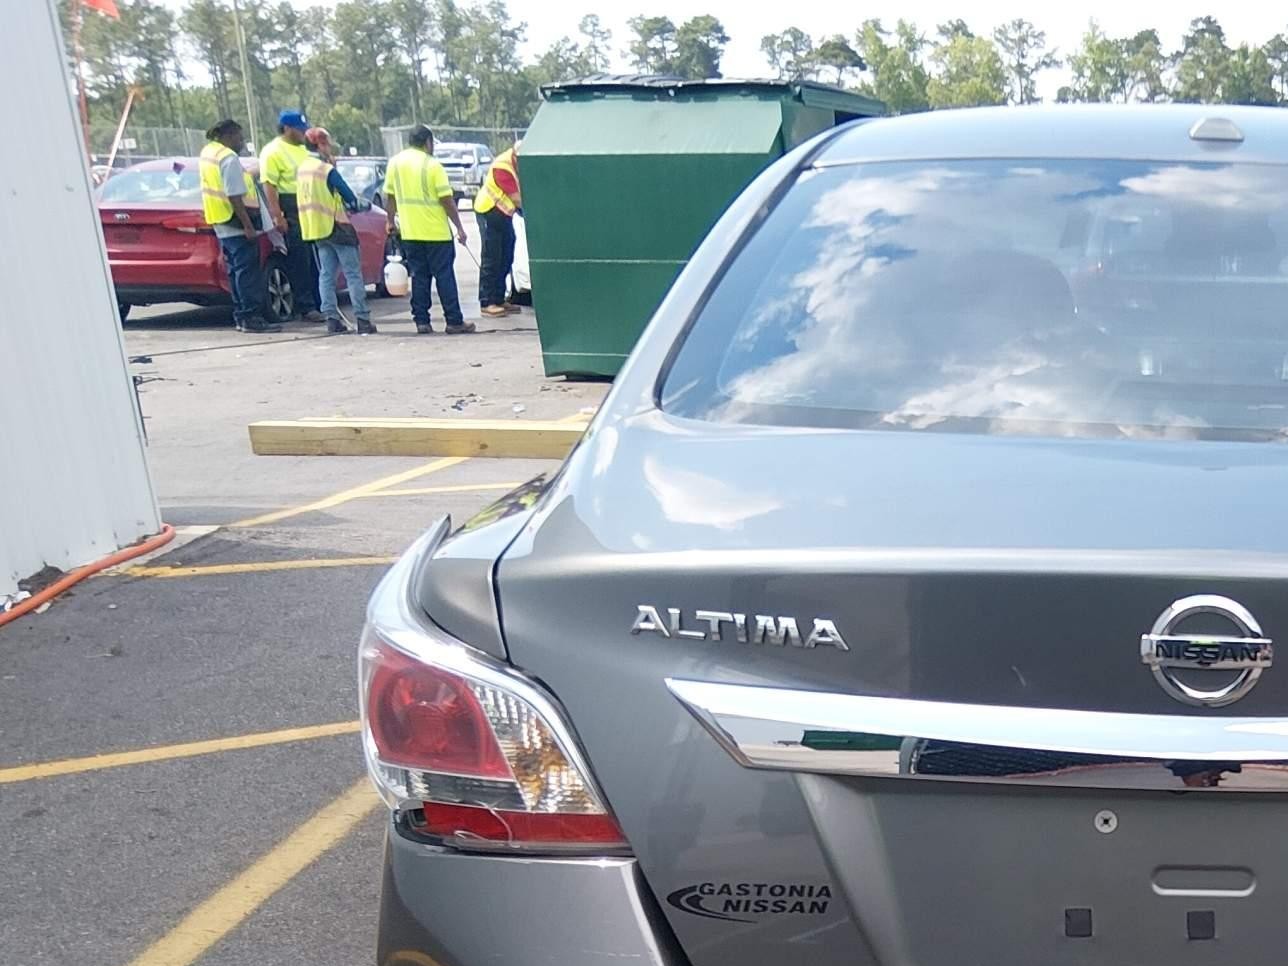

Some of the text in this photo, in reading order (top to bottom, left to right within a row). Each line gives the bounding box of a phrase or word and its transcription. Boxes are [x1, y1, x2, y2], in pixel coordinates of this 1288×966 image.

[631, 605, 850, 651] ALTIMA
[1155, 643, 1260, 662] NISSAN
[699, 883, 832, 898] GASTONIA
[723, 900, 829, 914] NISSAN
